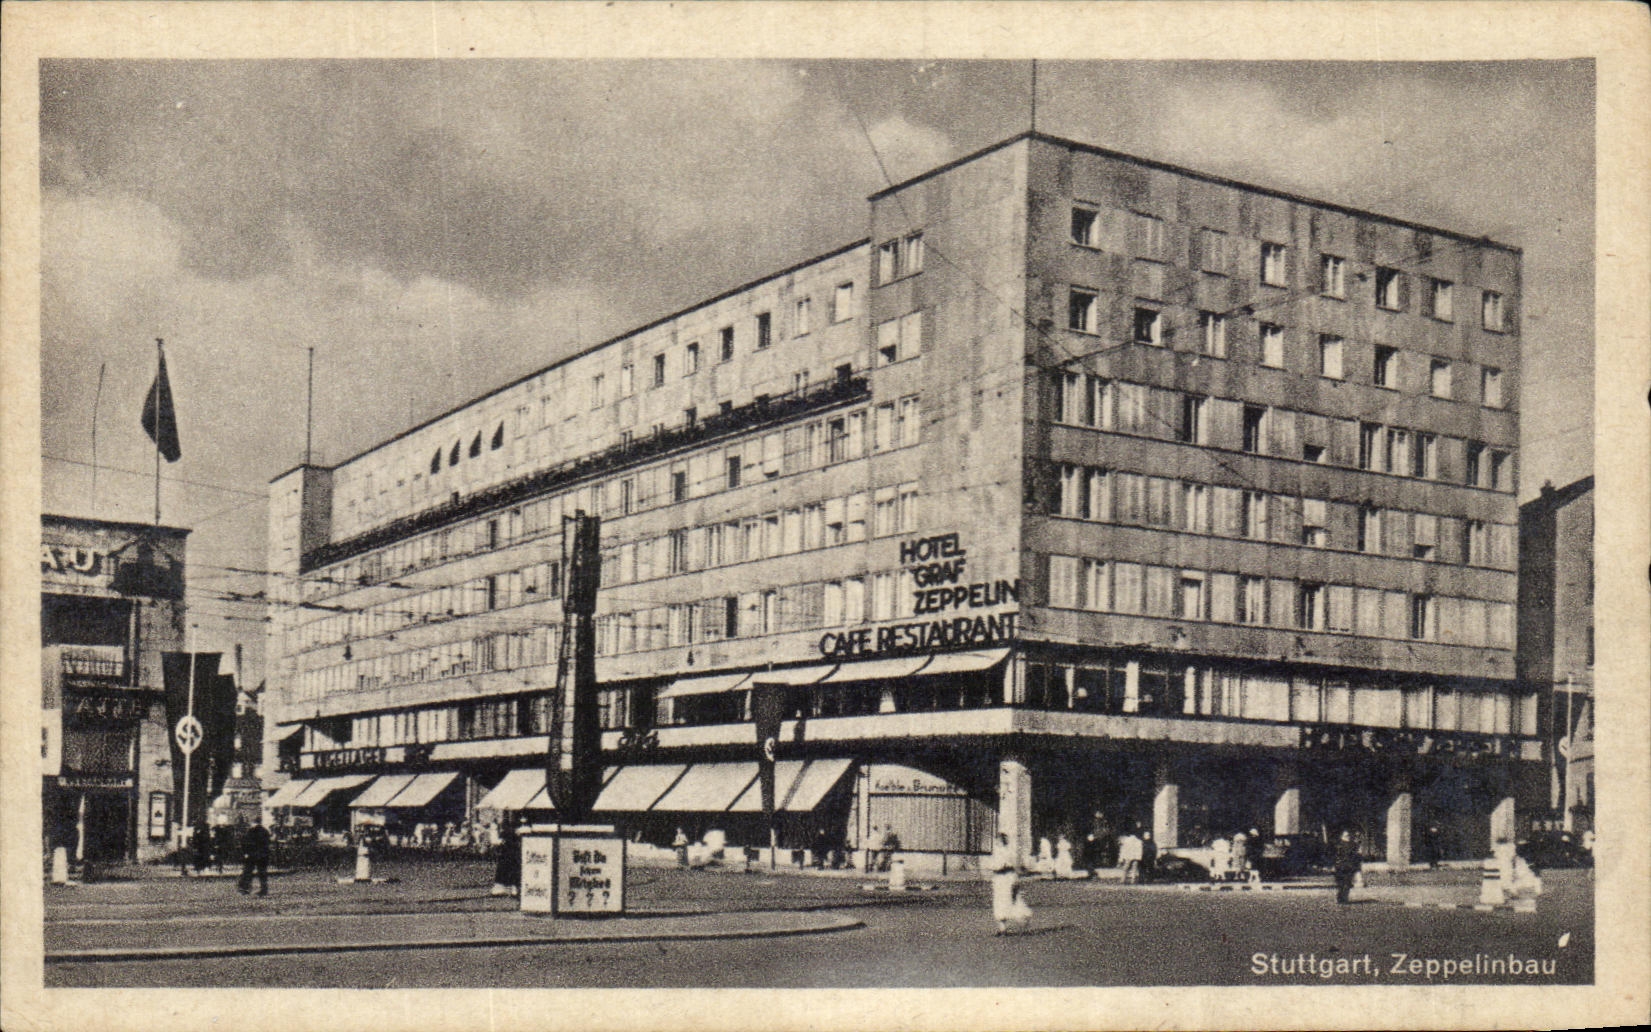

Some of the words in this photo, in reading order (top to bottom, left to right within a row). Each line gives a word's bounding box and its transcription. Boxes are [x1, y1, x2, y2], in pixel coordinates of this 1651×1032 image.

[900, 532, 966, 564] HOTEL
[912, 557, 966, 588] GRAF
[912, 578, 1020, 615] ZEPPELIN
[818, 629, 872, 658] CAFE
[877, 612, 1020, 653] RESTAURANT
